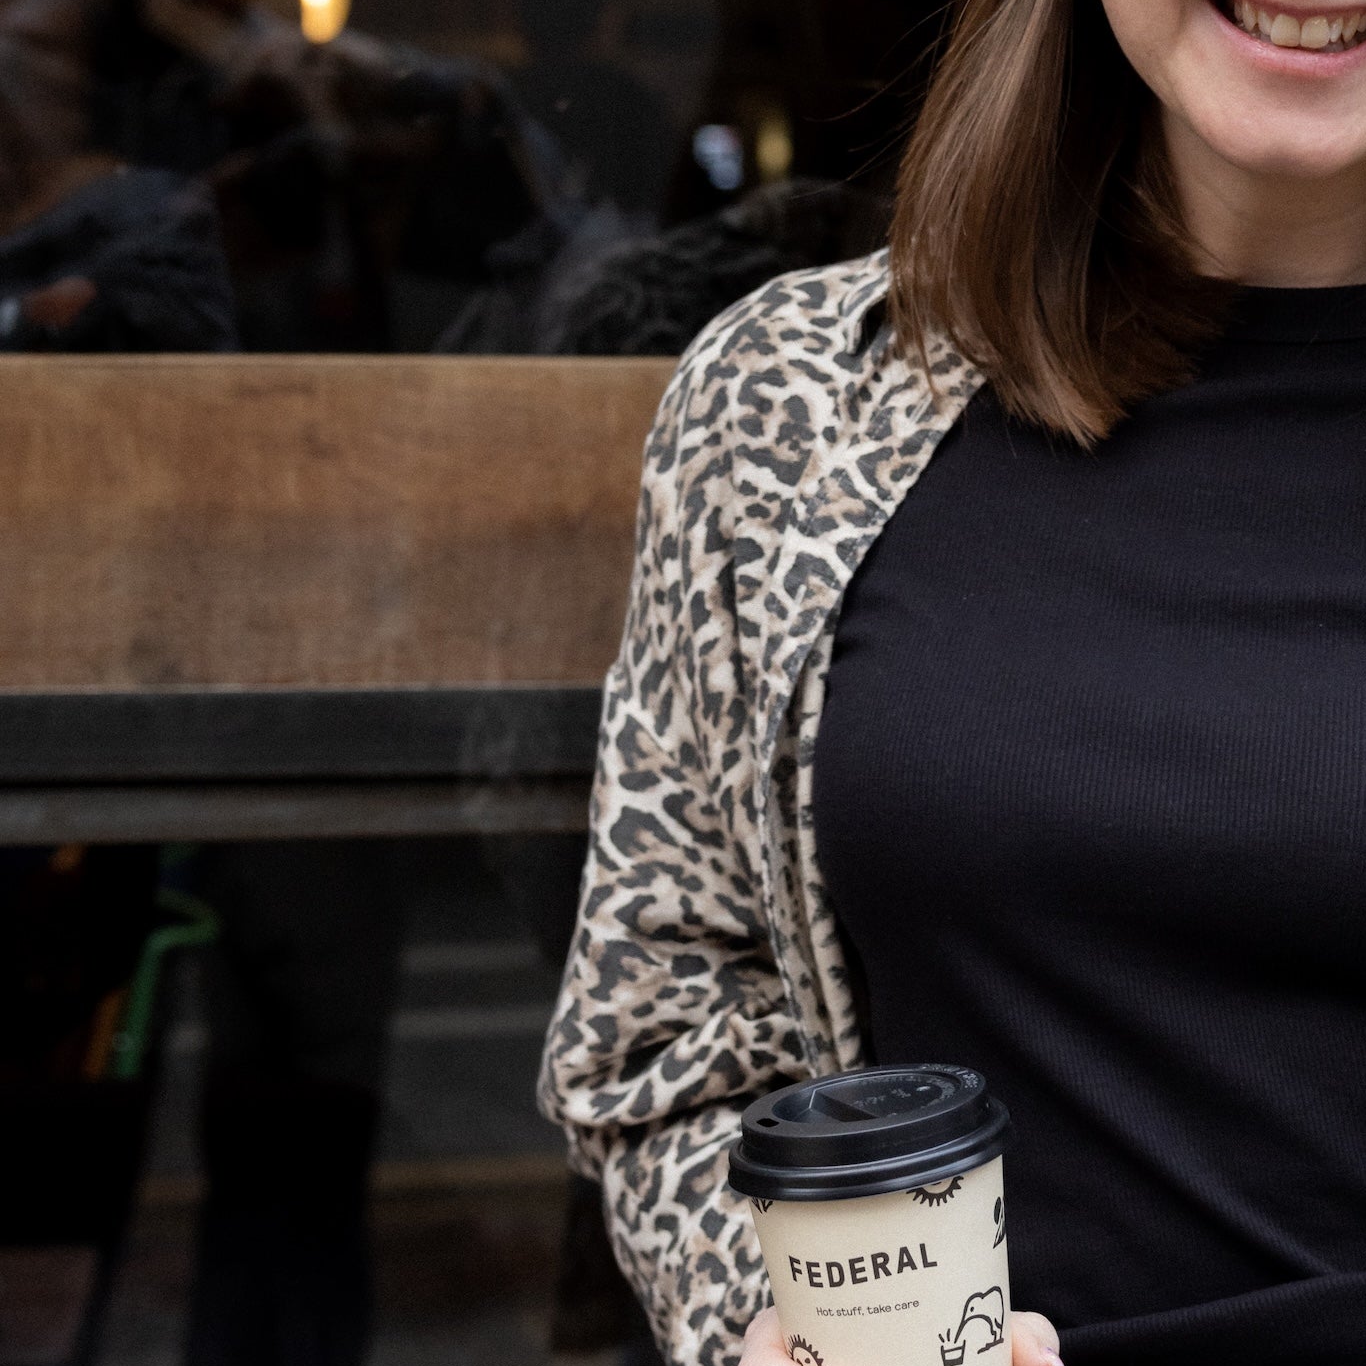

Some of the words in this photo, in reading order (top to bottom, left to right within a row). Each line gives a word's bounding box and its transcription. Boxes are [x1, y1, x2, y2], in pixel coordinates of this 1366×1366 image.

[788, 1243, 938, 1288] FEDERAL
[815, 1306, 835, 1317] Hot
[836, 1306, 865, 1317] stuff,
[866, 1304, 892, 1315] take
[894, 1299, 920, 1311] care
